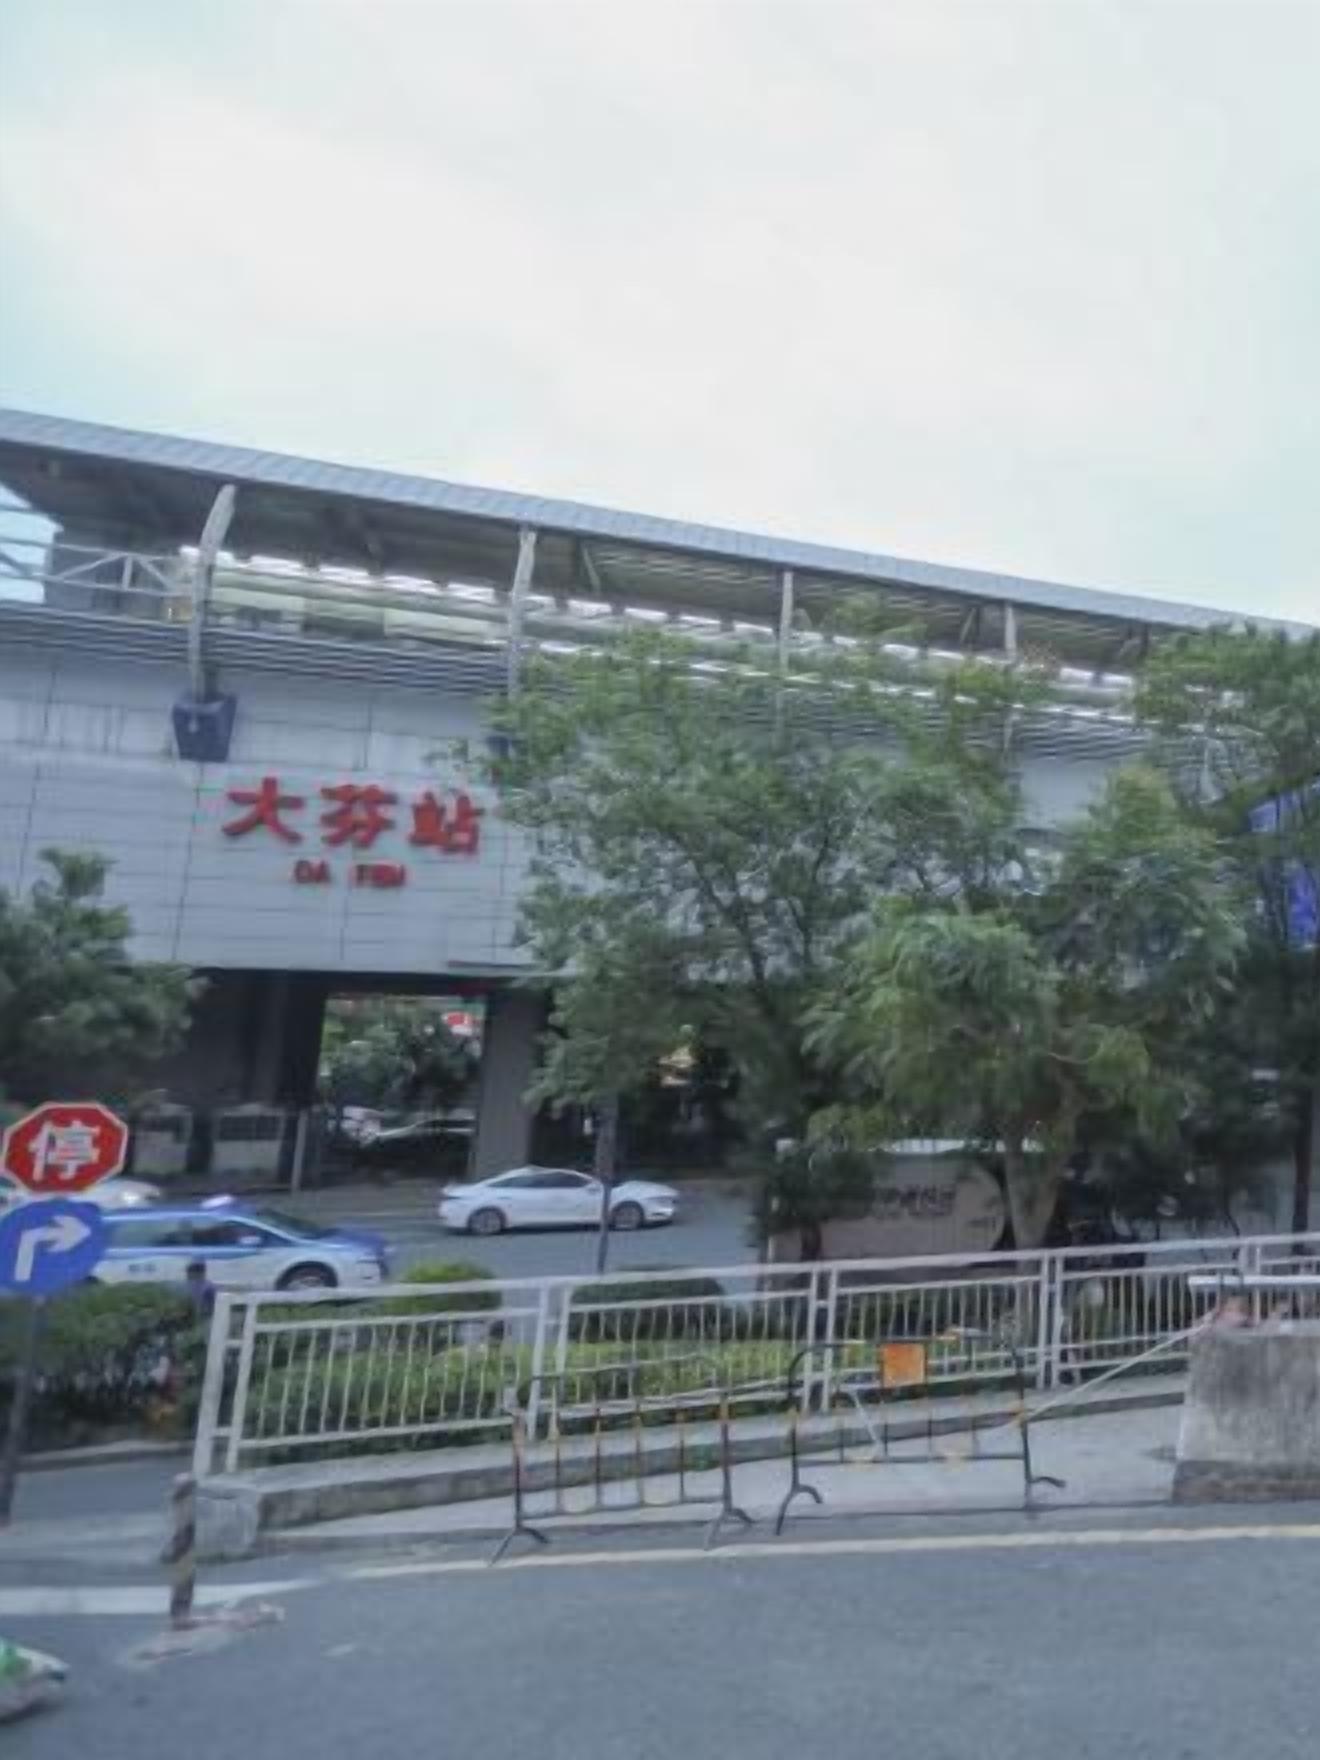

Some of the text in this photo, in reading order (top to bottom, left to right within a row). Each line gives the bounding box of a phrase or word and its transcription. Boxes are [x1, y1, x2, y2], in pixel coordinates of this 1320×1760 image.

[221, 776, 486, 854] 大芬站
[28, 1119, 101, 1181] 停
